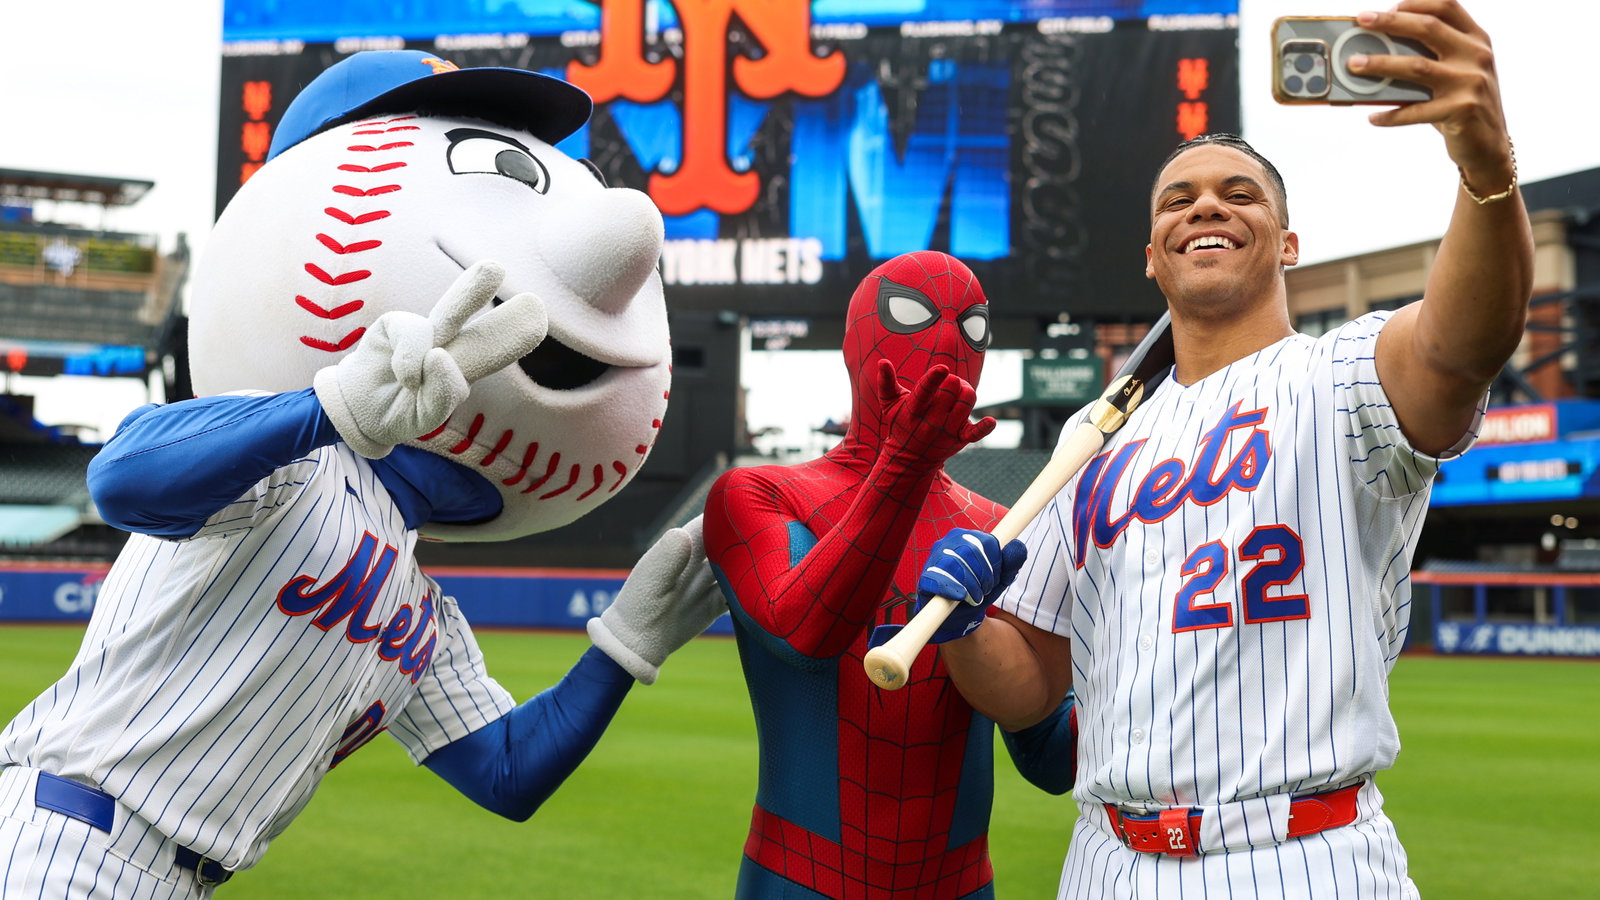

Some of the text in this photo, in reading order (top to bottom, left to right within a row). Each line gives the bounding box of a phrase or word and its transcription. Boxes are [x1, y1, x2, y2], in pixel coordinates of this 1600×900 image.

[663, 238, 823, 285] YORK METS
[1072, 398, 1272, 571] Mets
[277, 530, 437, 684] Mets
[1172, 523, 1311, 634] 22
[1167, 827, 1187, 849] 22
